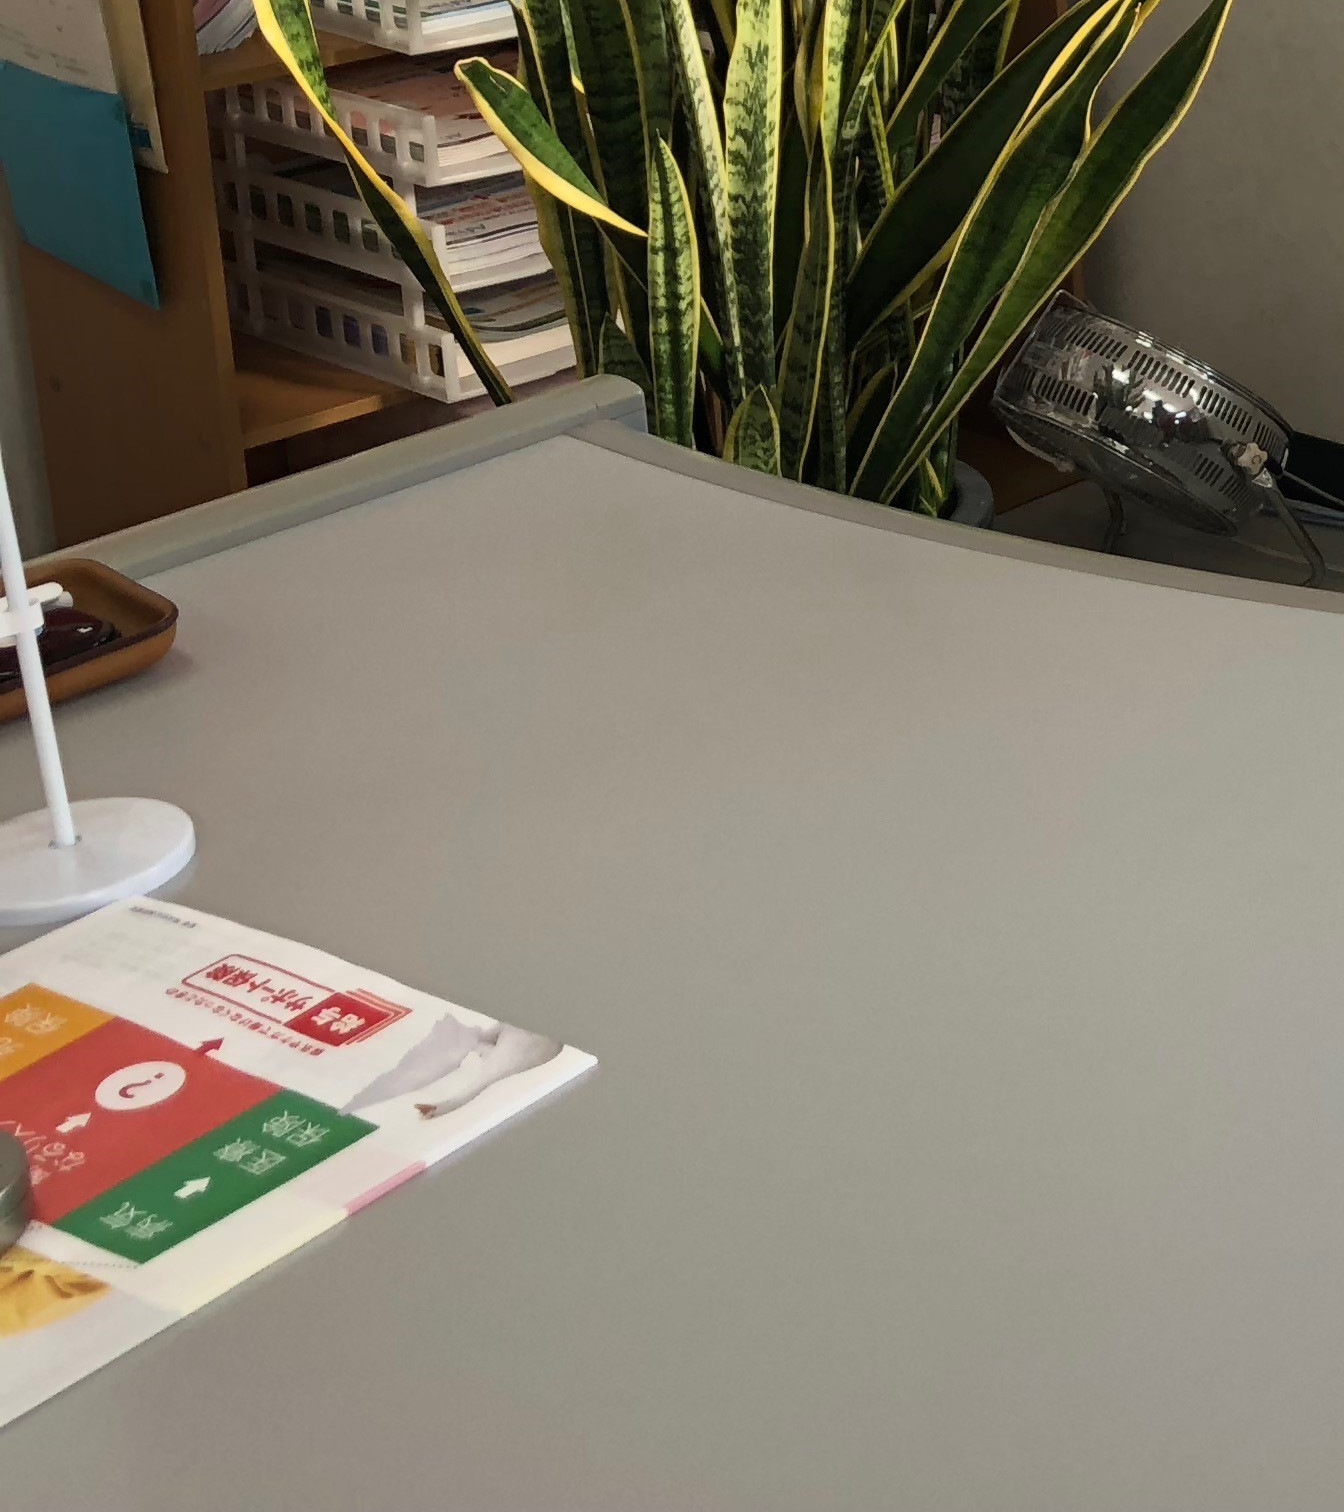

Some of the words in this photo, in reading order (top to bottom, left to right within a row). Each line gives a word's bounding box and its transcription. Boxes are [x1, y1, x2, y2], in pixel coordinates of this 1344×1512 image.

[206, 962, 317, 1013] サポート保険
[309, 1005, 365, 1035] 給与
[261, 1110, 330, 1148] 保険
[213, 1137, 285, 1175] 医療
[99, 1201, 174, 1239] 病気
